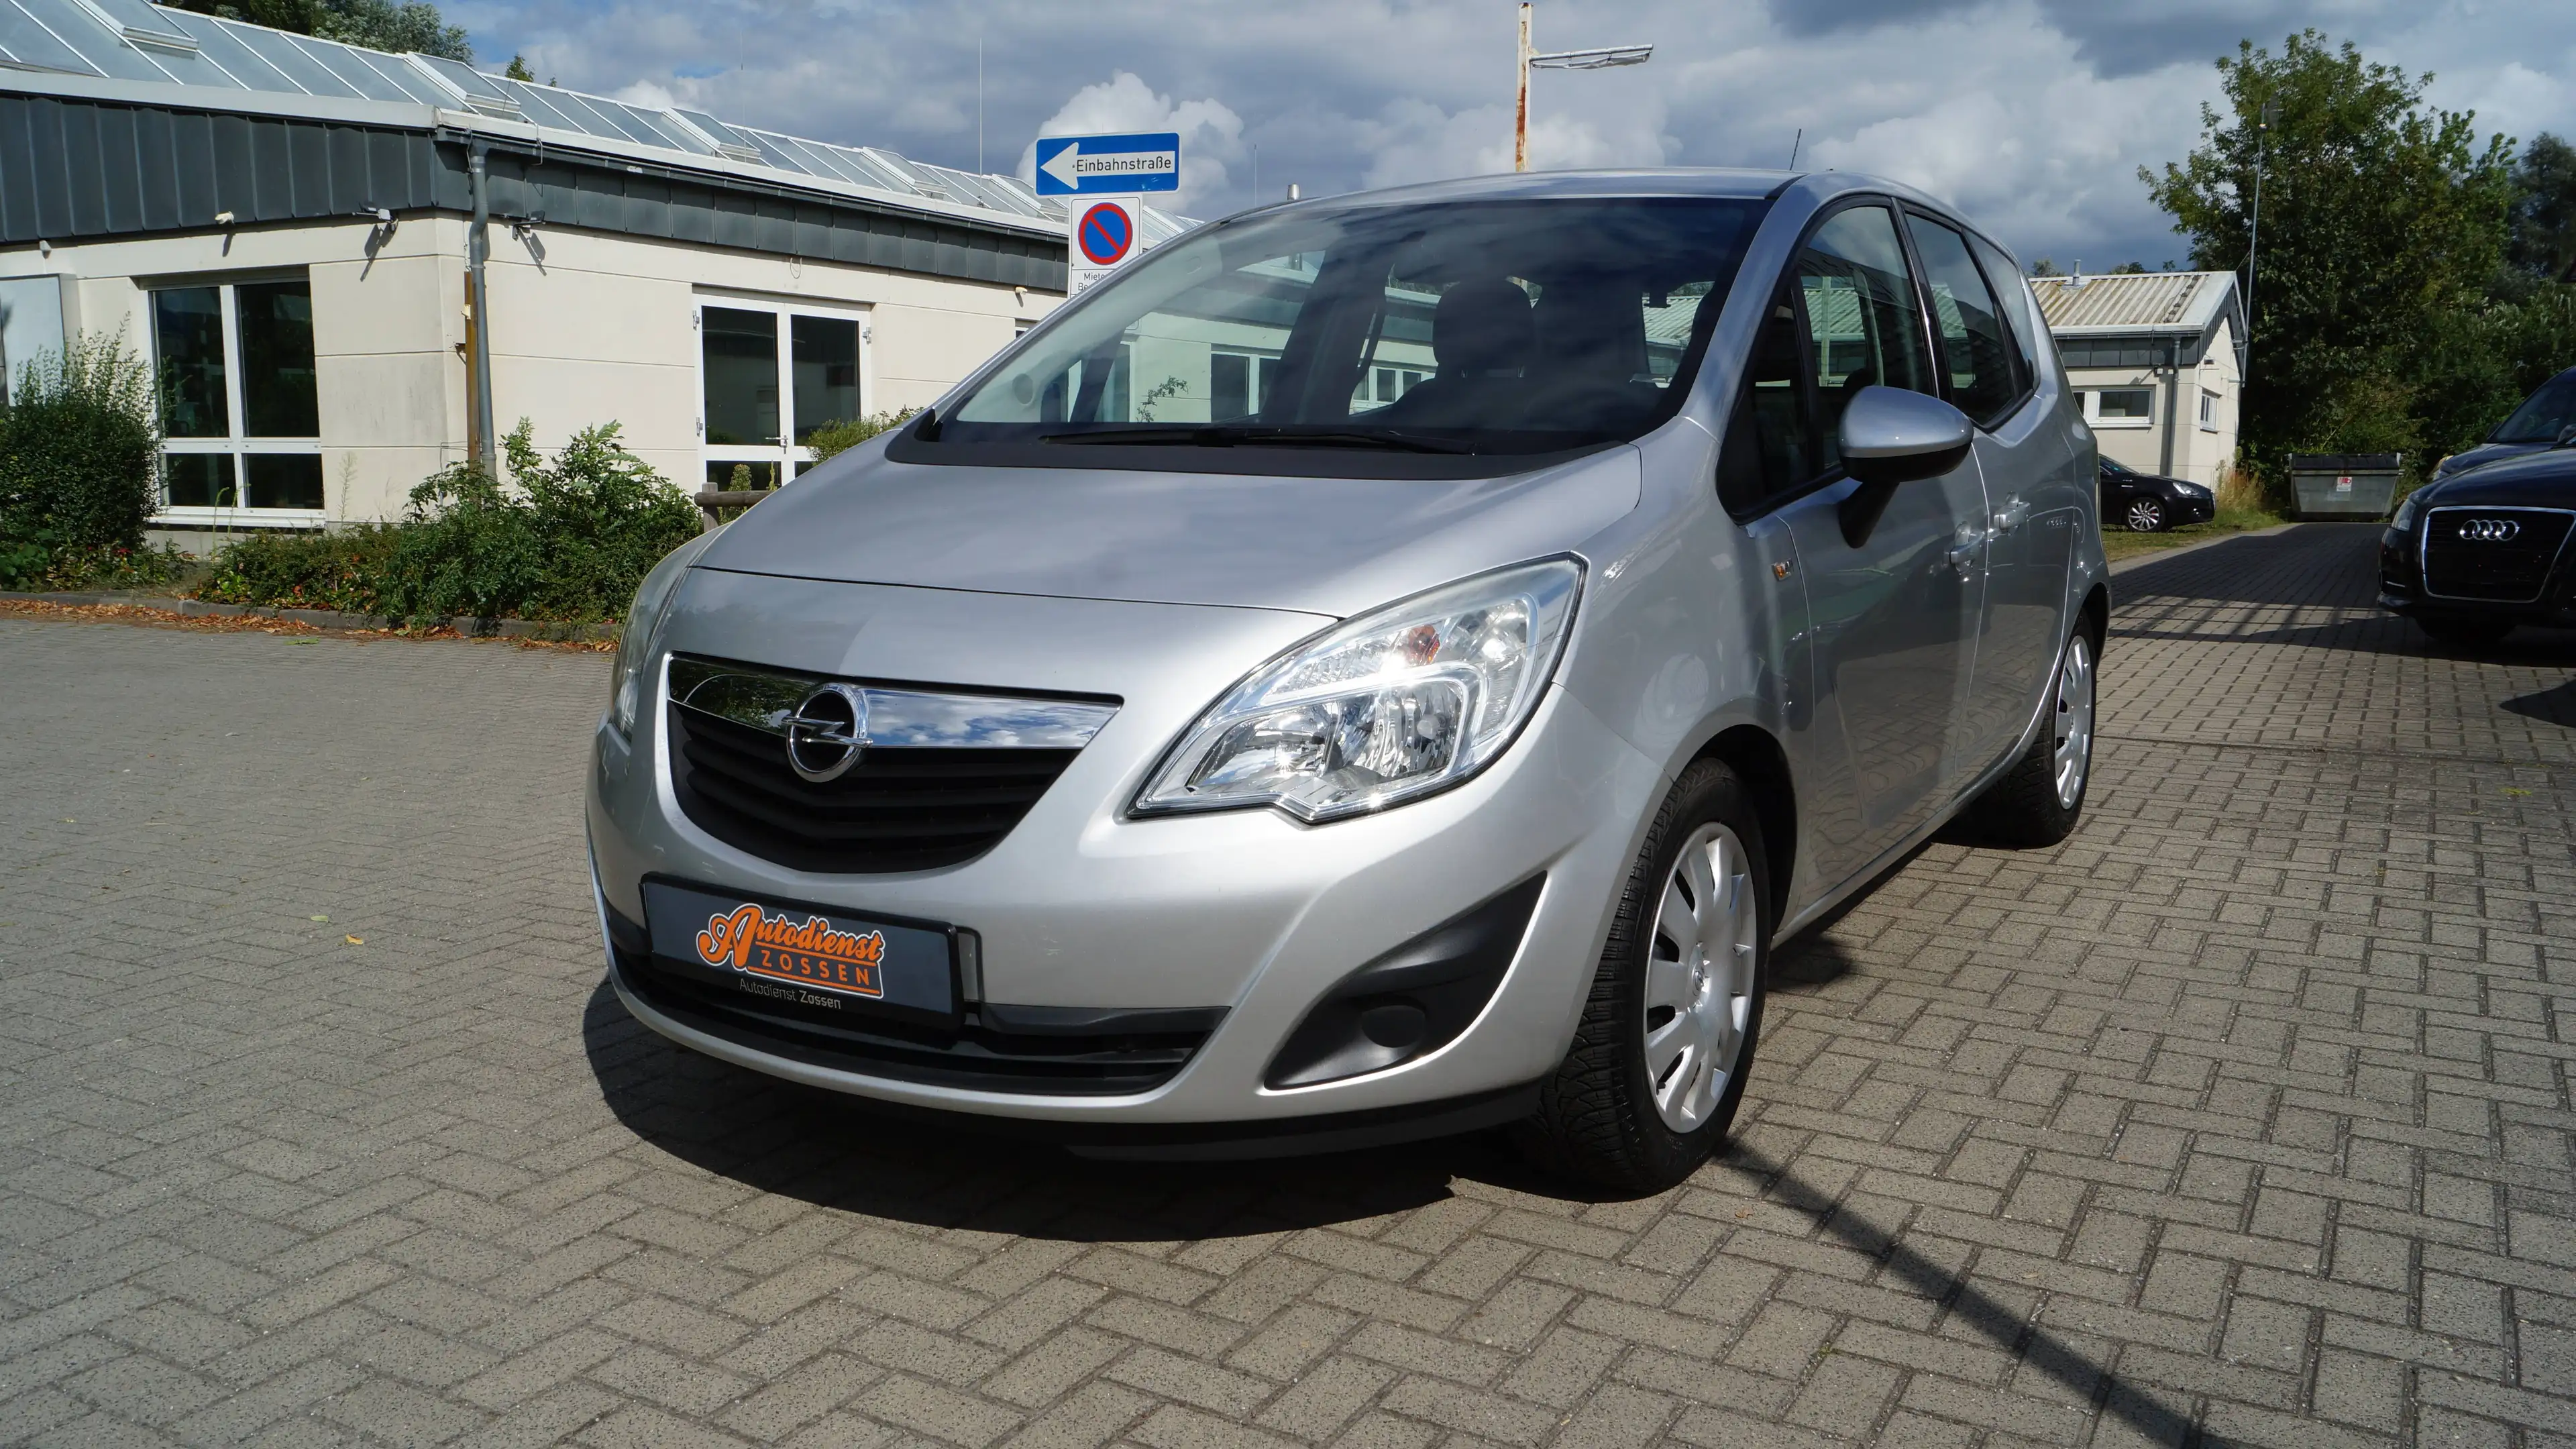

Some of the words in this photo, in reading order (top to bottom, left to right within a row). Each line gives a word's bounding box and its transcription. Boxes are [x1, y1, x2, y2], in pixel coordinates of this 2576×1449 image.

[1076, 156, 1172, 172] Einbahnstraße
[1083, 272, 1106, 281] Miete
[698, 906, 883, 969] Autodienst
[760, 949, 871, 986] ZOSSEN
[739, 977, 796, 1002] Autodienst
[800, 989, 841, 1010] Zossen
